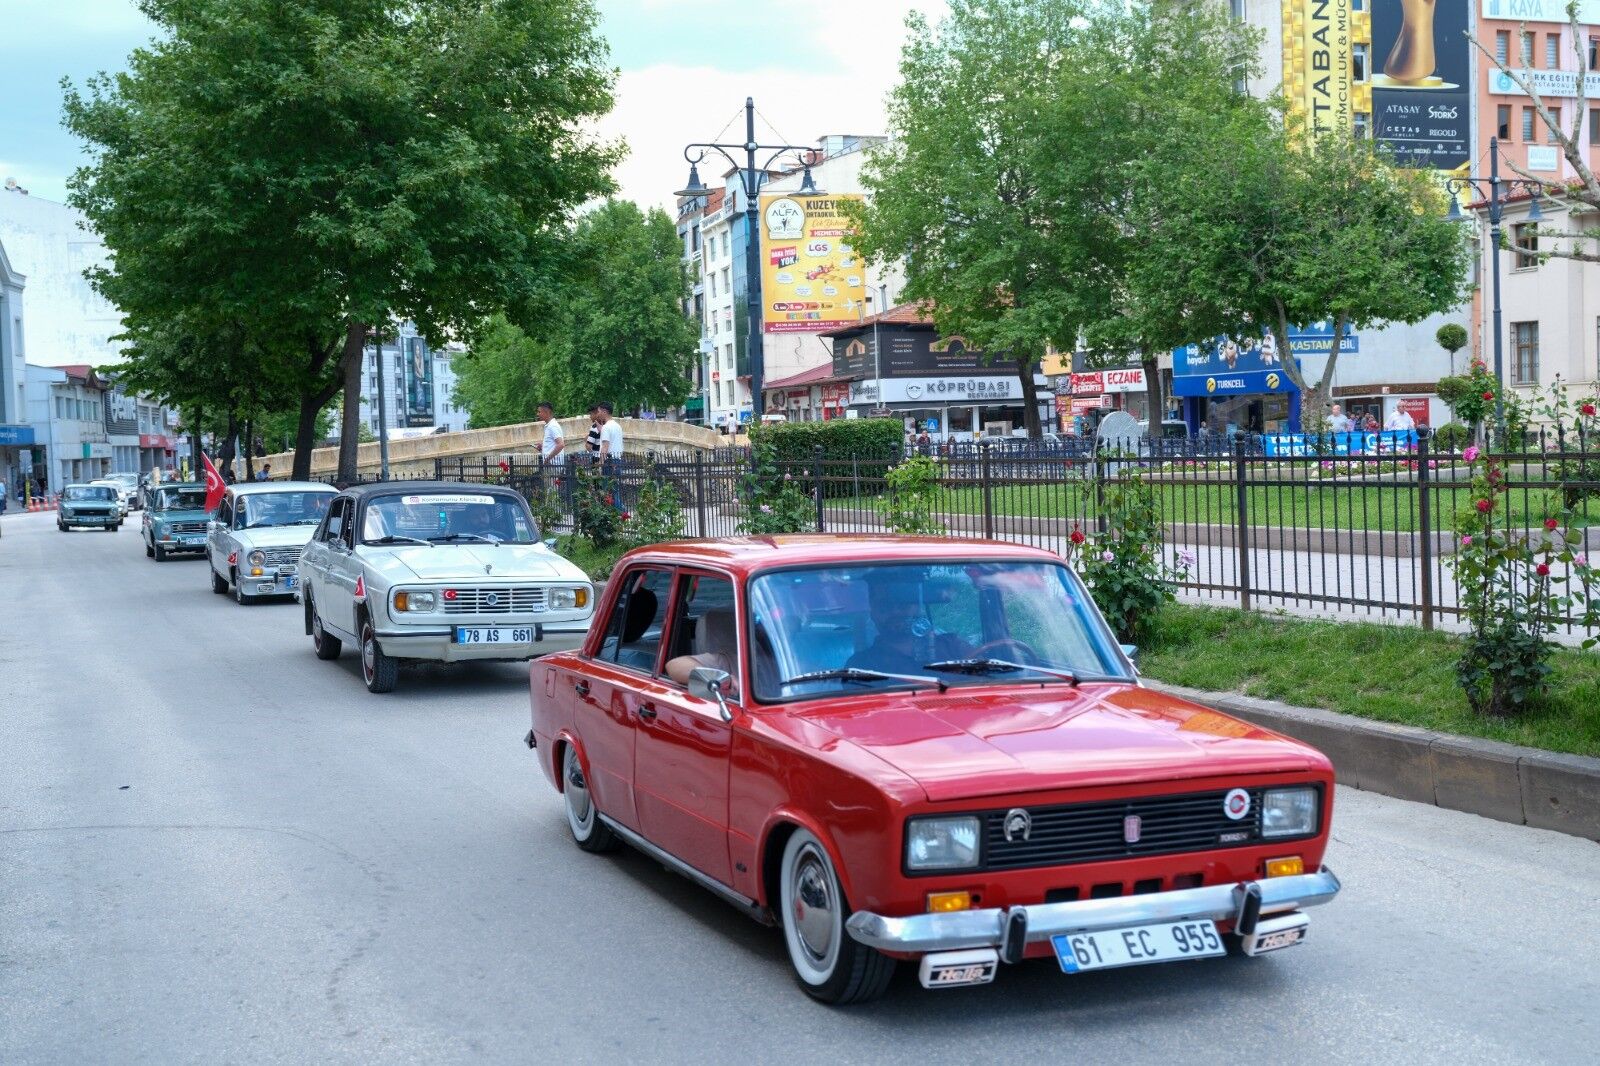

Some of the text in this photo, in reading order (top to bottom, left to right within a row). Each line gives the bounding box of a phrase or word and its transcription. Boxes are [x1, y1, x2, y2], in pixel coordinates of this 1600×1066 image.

[1522, 73, 1546, 81] TRK
[1385, 104, 1420, 114] ATASAY
[1428, 105, 1458, 119] STORKS
[1429, 129, 1457, 137] REGOLD
[806, 200, 836, 210] KUZEY
[808, 244, 828, 252] LGS
[1107, 371, 1142, 385] ECZANE
[1217, 380, 1246, 389] TURKCELL
[967, 391, 1009, 399] RESTAURANT
[1104, 397, 1110, 406] E
[466, 629, 531, 642] 78 AS 661
[1072, 936, 1103, 965] 61
[1121, 929, 1157, 958] EC
[1171, 923, 1219, 953] 955
[937, 967, 985, 982] Hella
